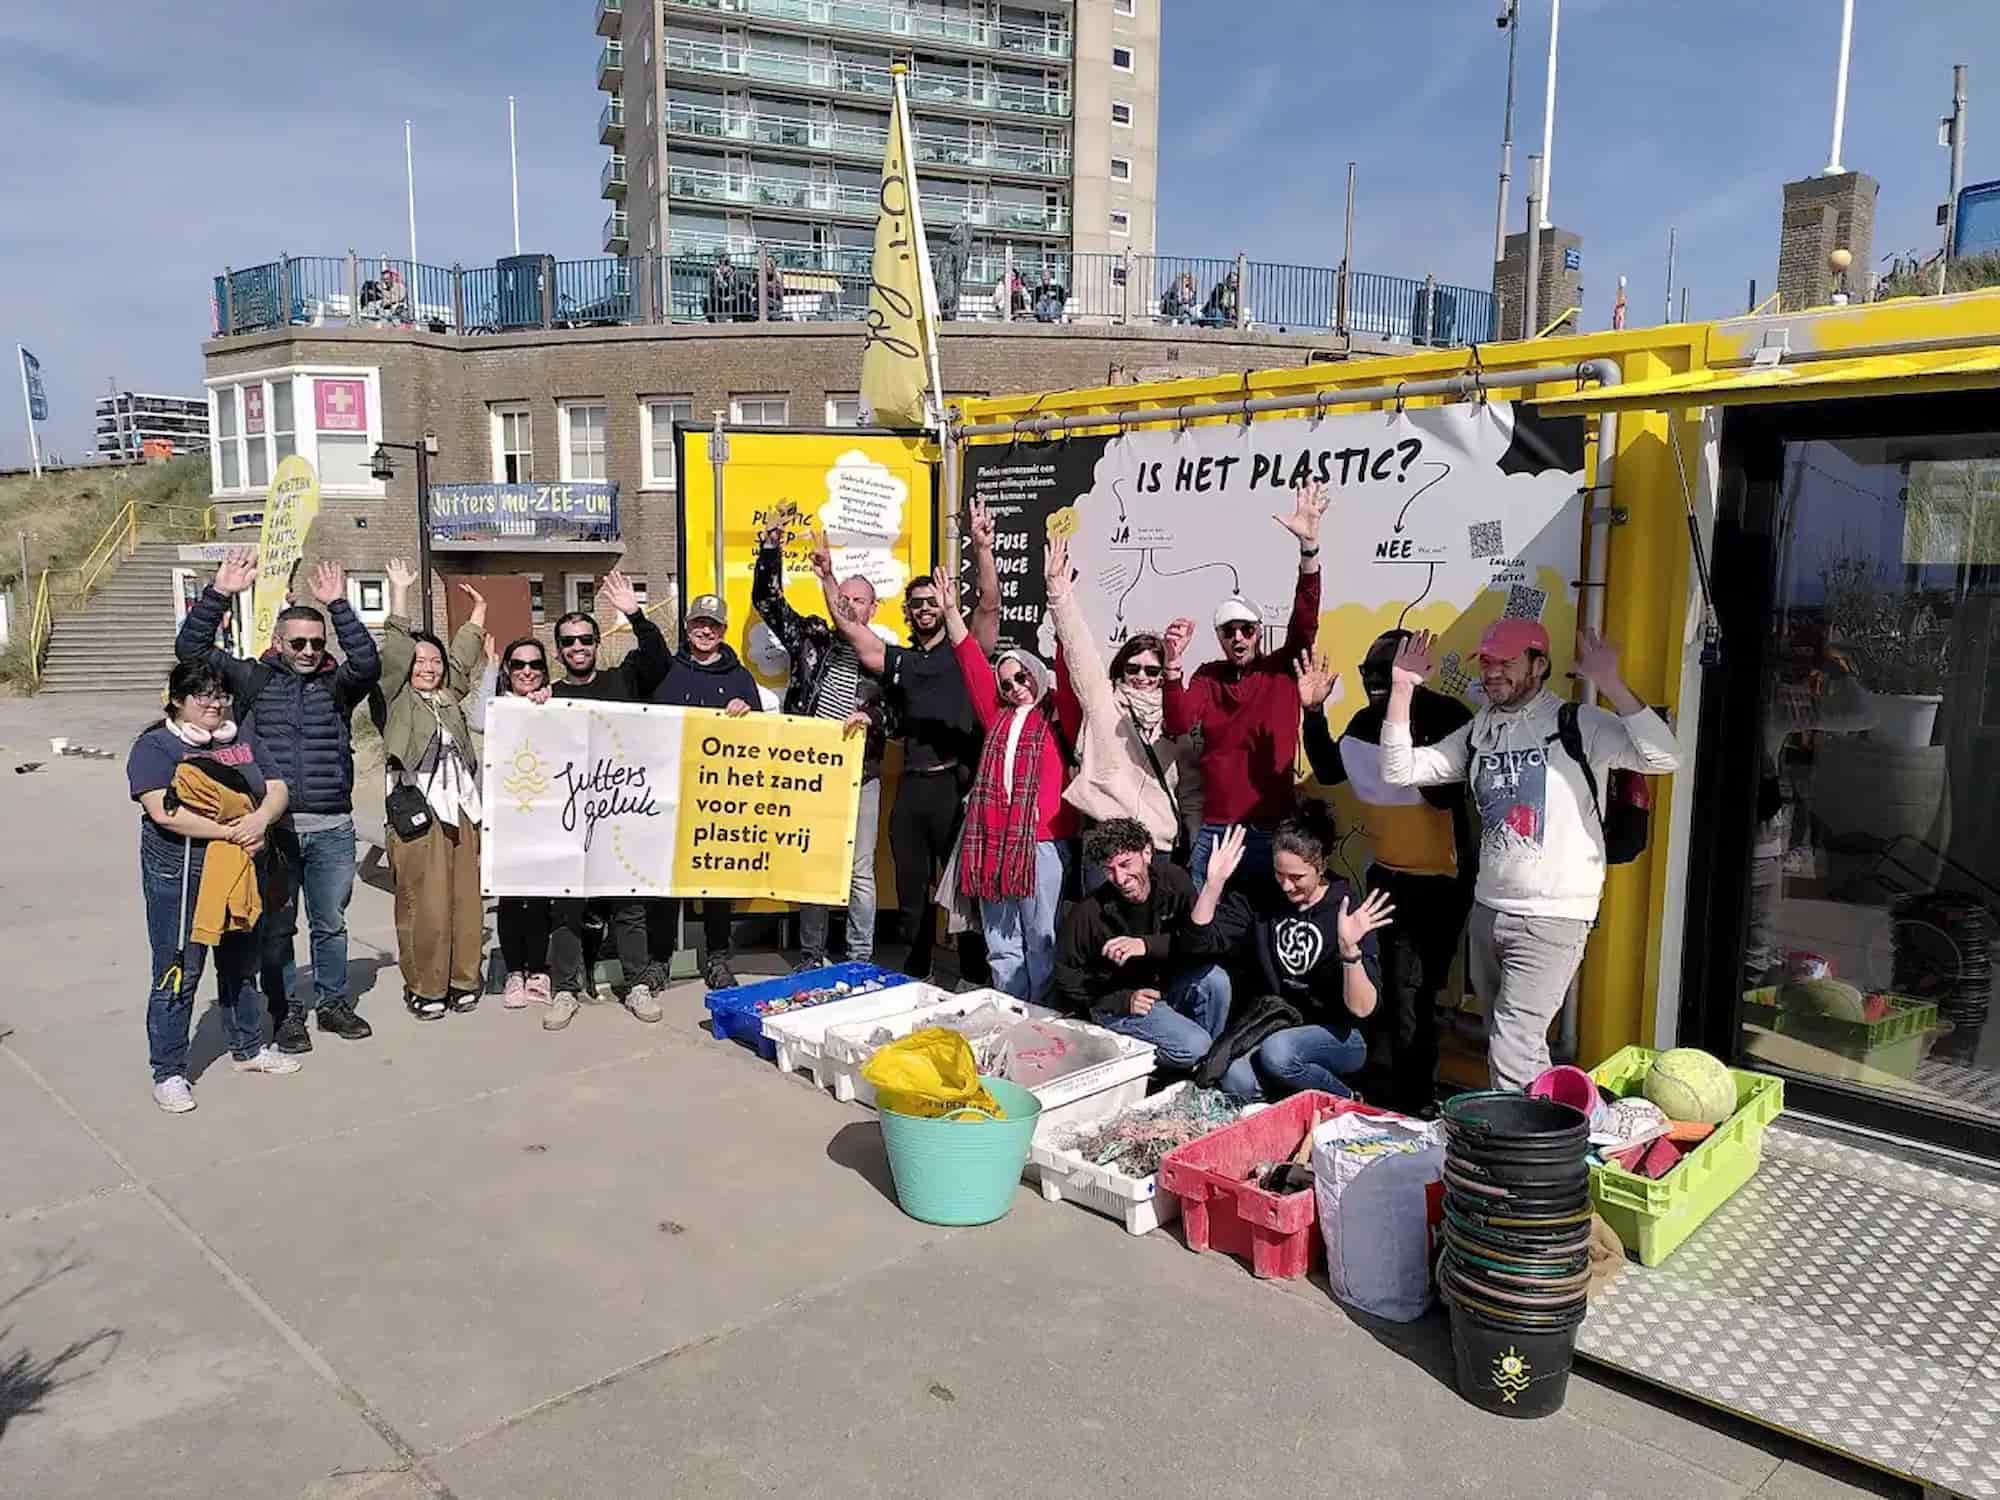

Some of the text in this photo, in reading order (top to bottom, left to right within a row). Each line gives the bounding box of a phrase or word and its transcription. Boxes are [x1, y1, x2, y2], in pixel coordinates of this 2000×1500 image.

[1136, 437, 1423, 493] IS HET PLASTIC?
[431, 491, 496, 518] Jutters
[752, 510, 814, 526] PLTIC
[990, 533, 1029, 551] FUSE
[1111, 526, 1130, 543] JA
[1376, 540, 1413, 558] NEE
[998, 605, 1039, 623] YCLE!
[1109, 626, 1129, 643] JA
[701, 736, 844, 767] Onze voeten
[699, 765, 822, 792] in het zand
[553, 758, 646, 832] Jutters
[696, 799, 791, 817] voor een
[584, 786, 662, 853] geluk
[693, 822, 810, 853] plastic vrij
[691, 851, 770, 871] strand!
